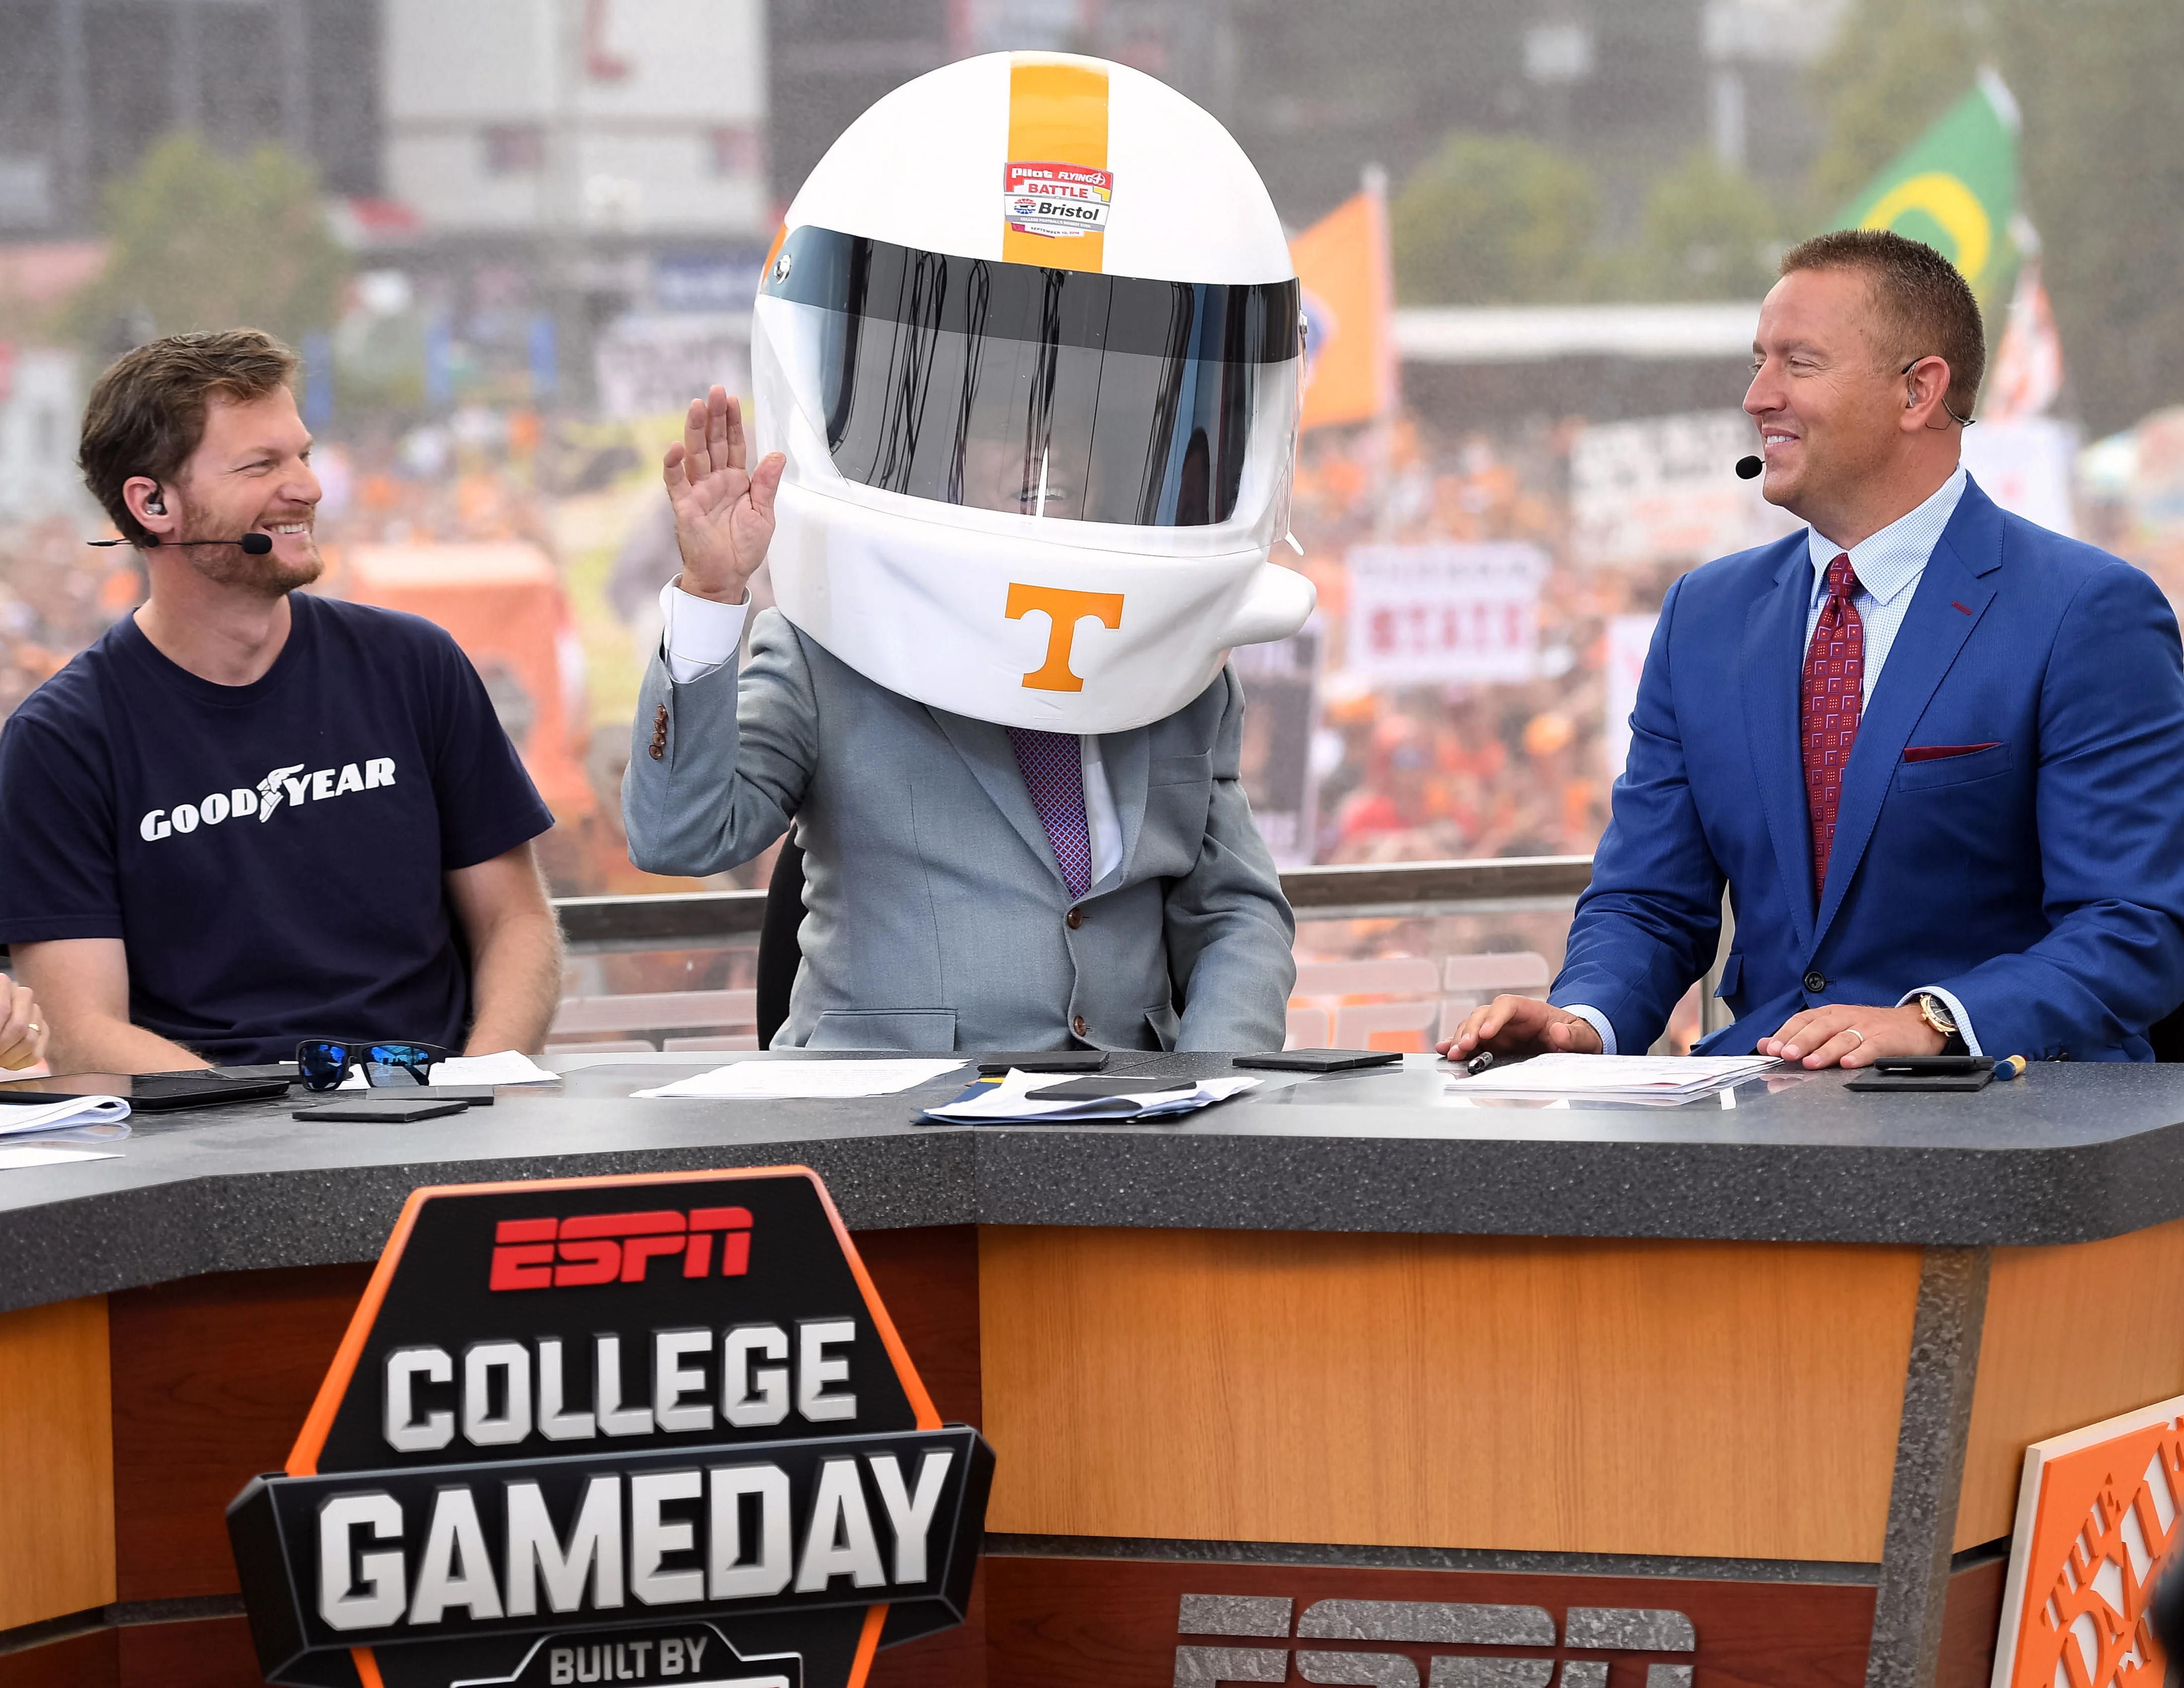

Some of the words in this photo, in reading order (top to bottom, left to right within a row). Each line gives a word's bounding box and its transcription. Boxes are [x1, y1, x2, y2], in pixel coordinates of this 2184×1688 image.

[1028, 184, 1089, 199] BATTLE
[1058, 171, 1093, 182] FLYING
[1031, 226, 1060, 235] SEPTEMBER
[1038, 202, 1099, 221] Bristol
[1005, 582, 1125, 693] T
[489, 1206, 753, 1291] ESPN
[385, 1318, 857, 1453] COLLEGE
[318, 1449, 954, 1630] GAMEDAY
[550, 1641, 653, 1685] BUILT
[660, 1637, 708, 1676] BY
